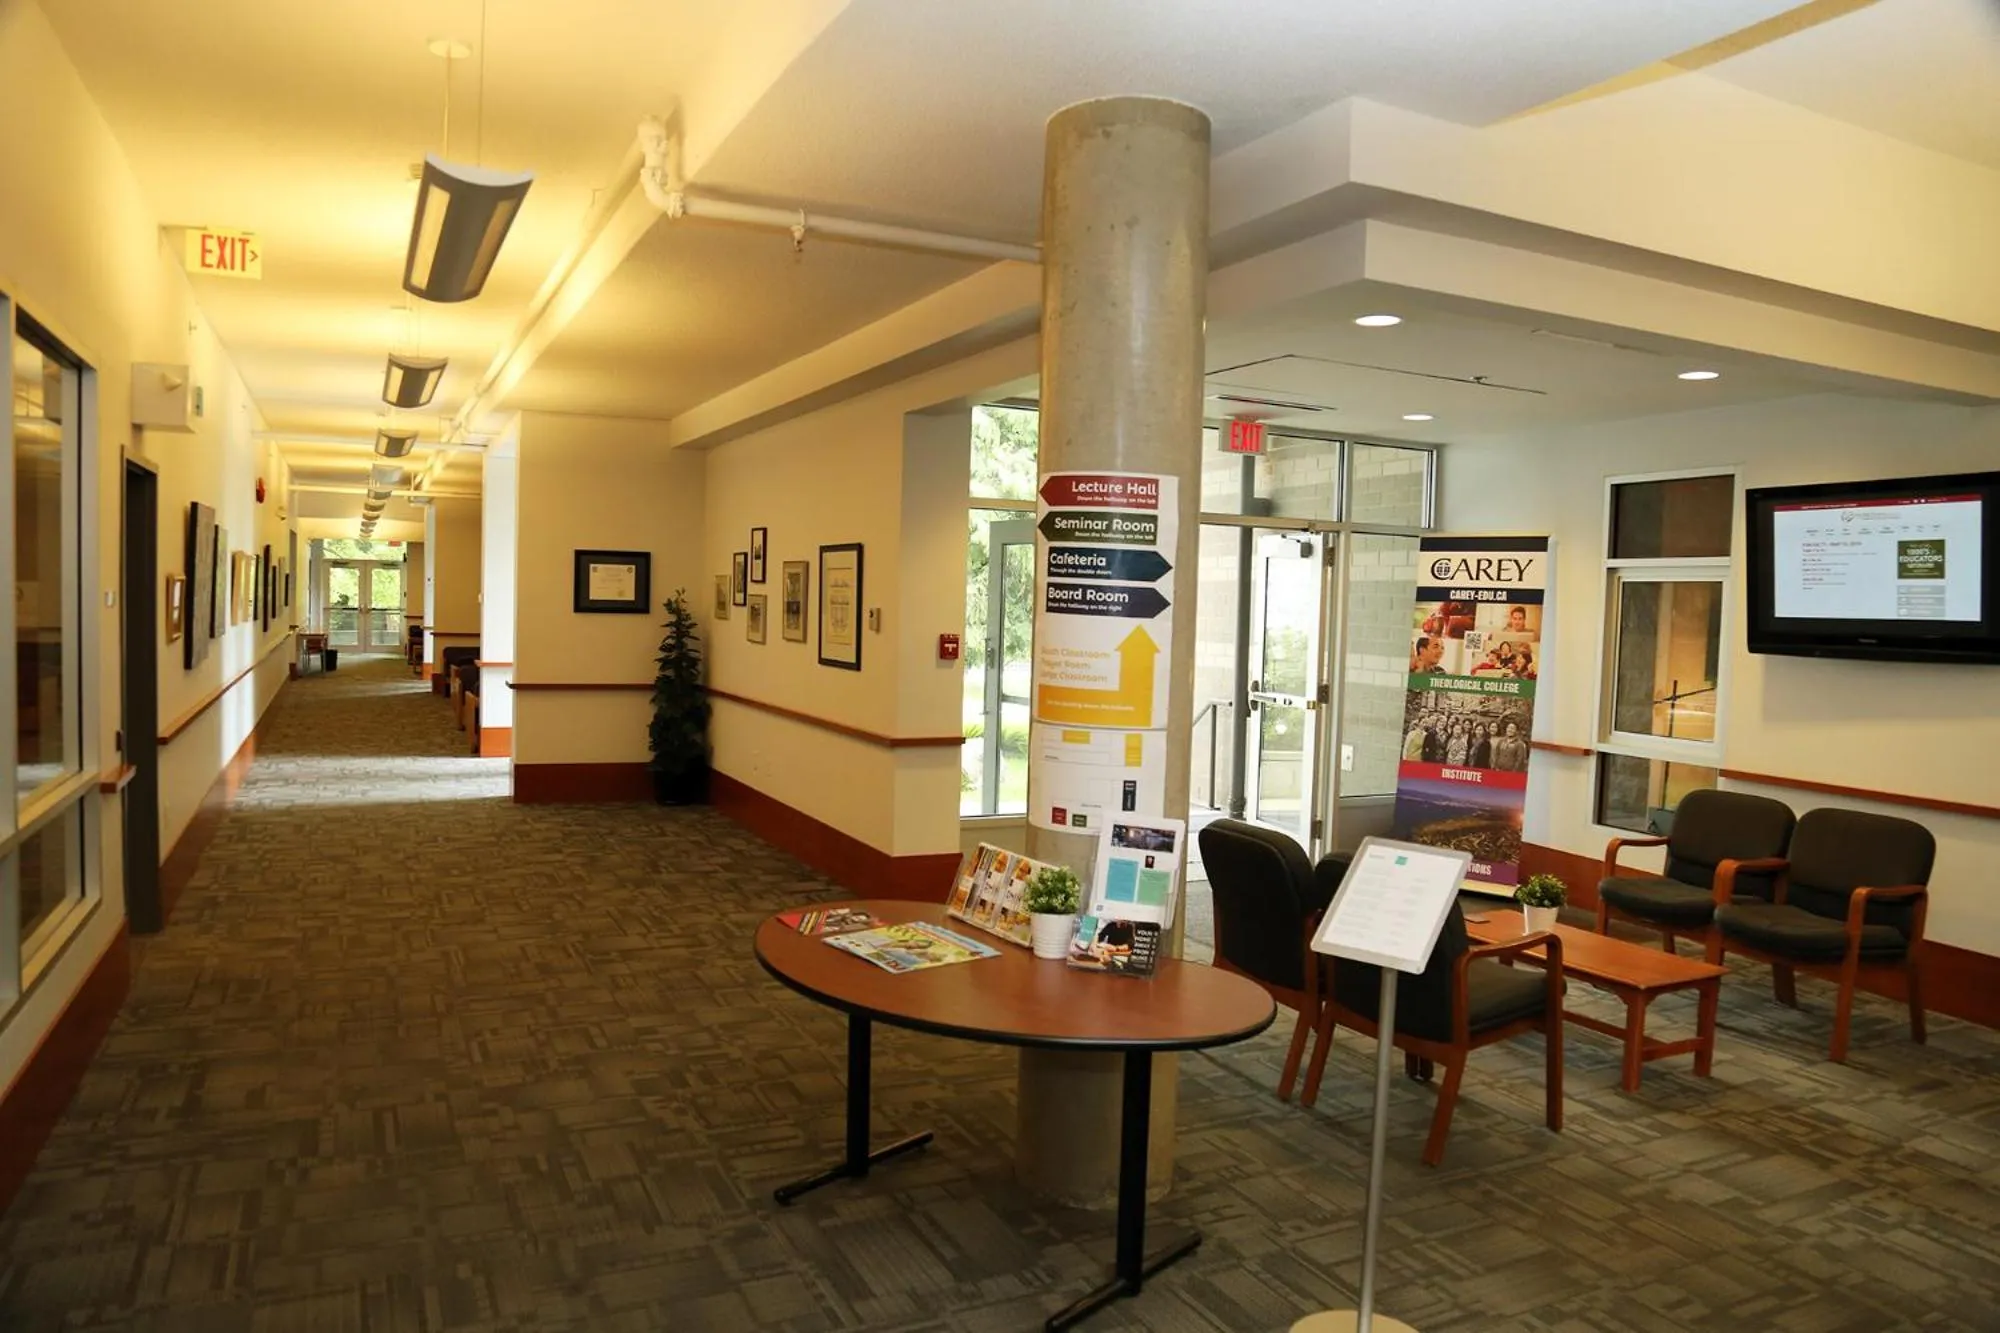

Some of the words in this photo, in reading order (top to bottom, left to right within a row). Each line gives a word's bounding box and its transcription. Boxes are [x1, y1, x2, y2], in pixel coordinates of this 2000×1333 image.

[201, 234, 250, 272] EXIT
[1230, 420, 1263, 452] EXIT
[1072, 481, 1122, 493] Lecture
[1127, 483, 1157, 495] Hall
[1055, 516, 1108, 530] Seminar
[1112, 518, 1155, 532] Room
[1050, 553, 1106, 566] Cafeteria
[1431, 557, 1533, 582] CAREY
[1048, 588, 1082, 600] Board
[1086, 590, 1128, 602] Room
[1450, 590, 1508, 601] CAREY-EDU.CA
[1430, 678, 1482, 691] THEOLOGICAL
[1484, 681, 1520, 694] COLLEGE
[1442, 768, 1482, 782] INSTITUTE
[1466, 862, 1492, 875] TIONS
